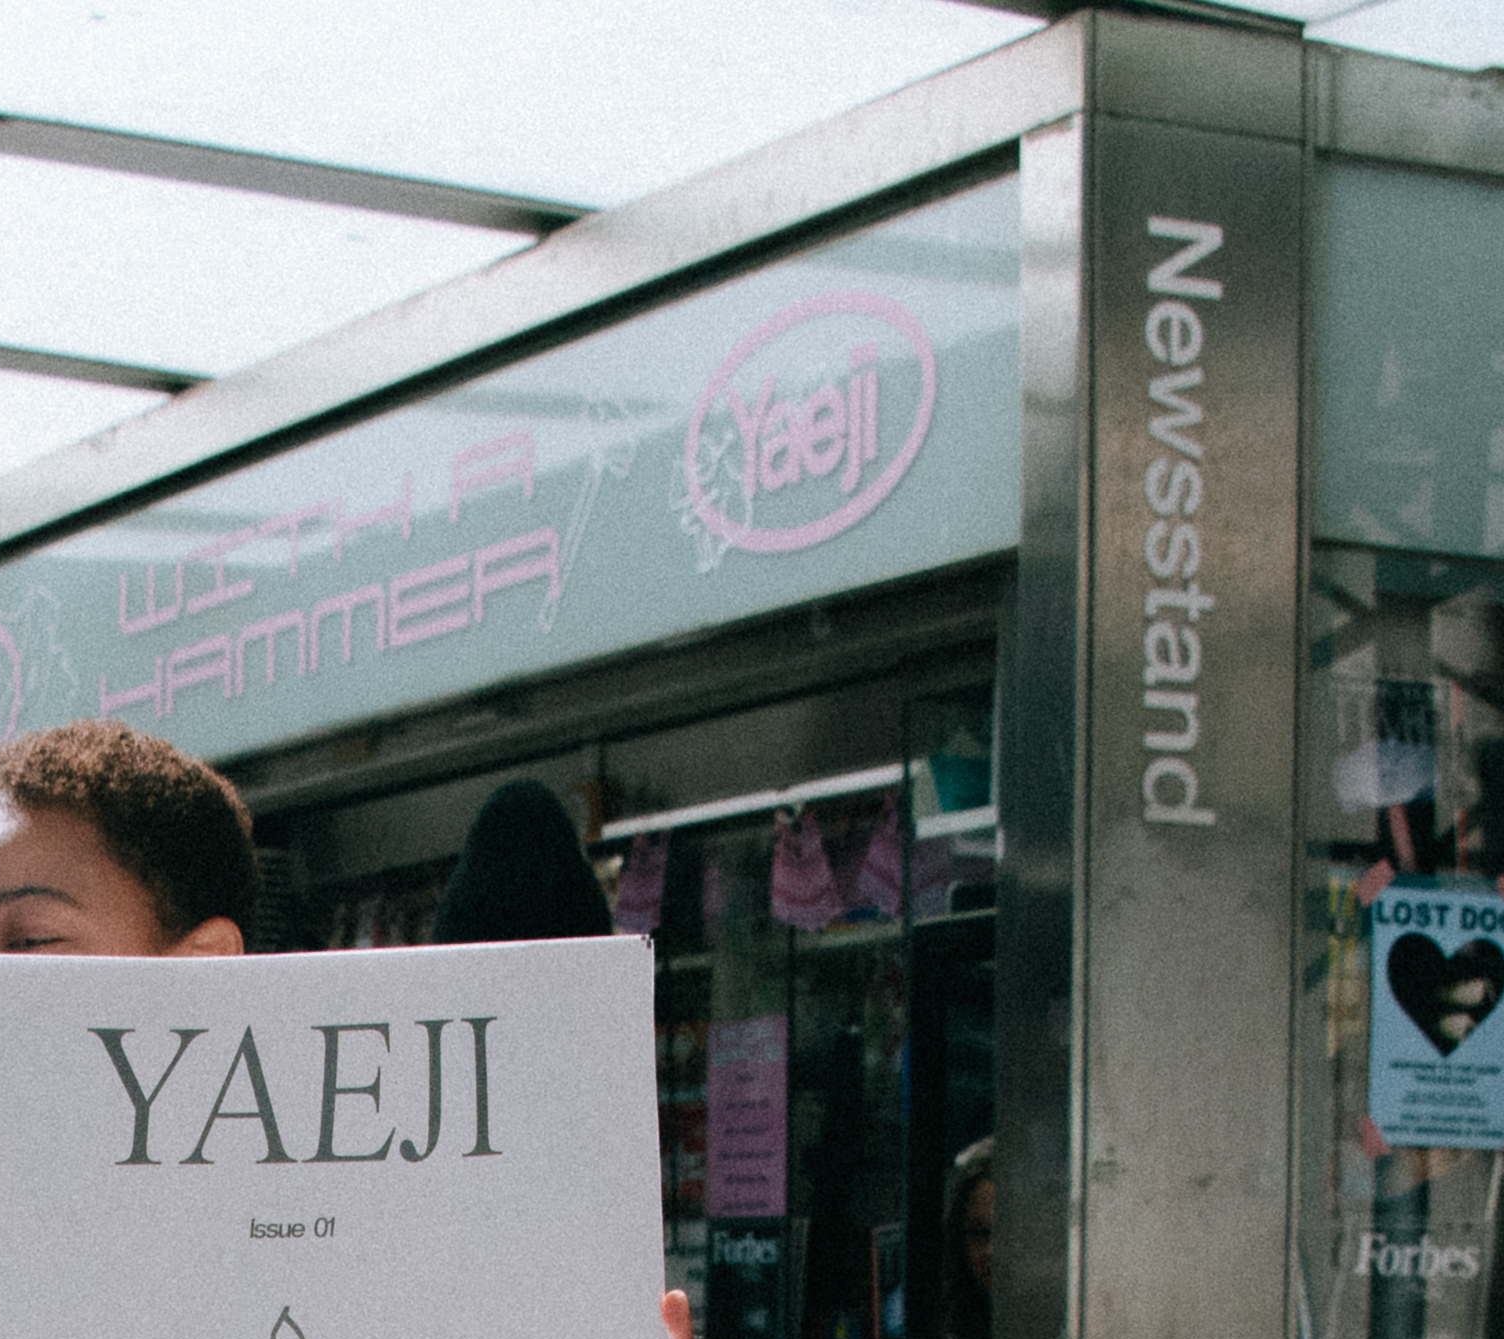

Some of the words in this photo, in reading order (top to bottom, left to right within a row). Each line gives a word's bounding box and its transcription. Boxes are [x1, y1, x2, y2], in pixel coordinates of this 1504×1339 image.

[728, 337, 880, 496] Yaeji
[120, 471, 411, 634] WITH
[450, 429, 535, 523] A
[1140, 214, 1224, 828] Newsstand
[1375, 901, 1451, 929] LOST
[86, 1015, 504, 1166] YAEJI
[248, 1216, 305, 1239] Issue
[313, 1216, 336, 1238] 01
[1355, 1231, 1479, 1278] Forbes
